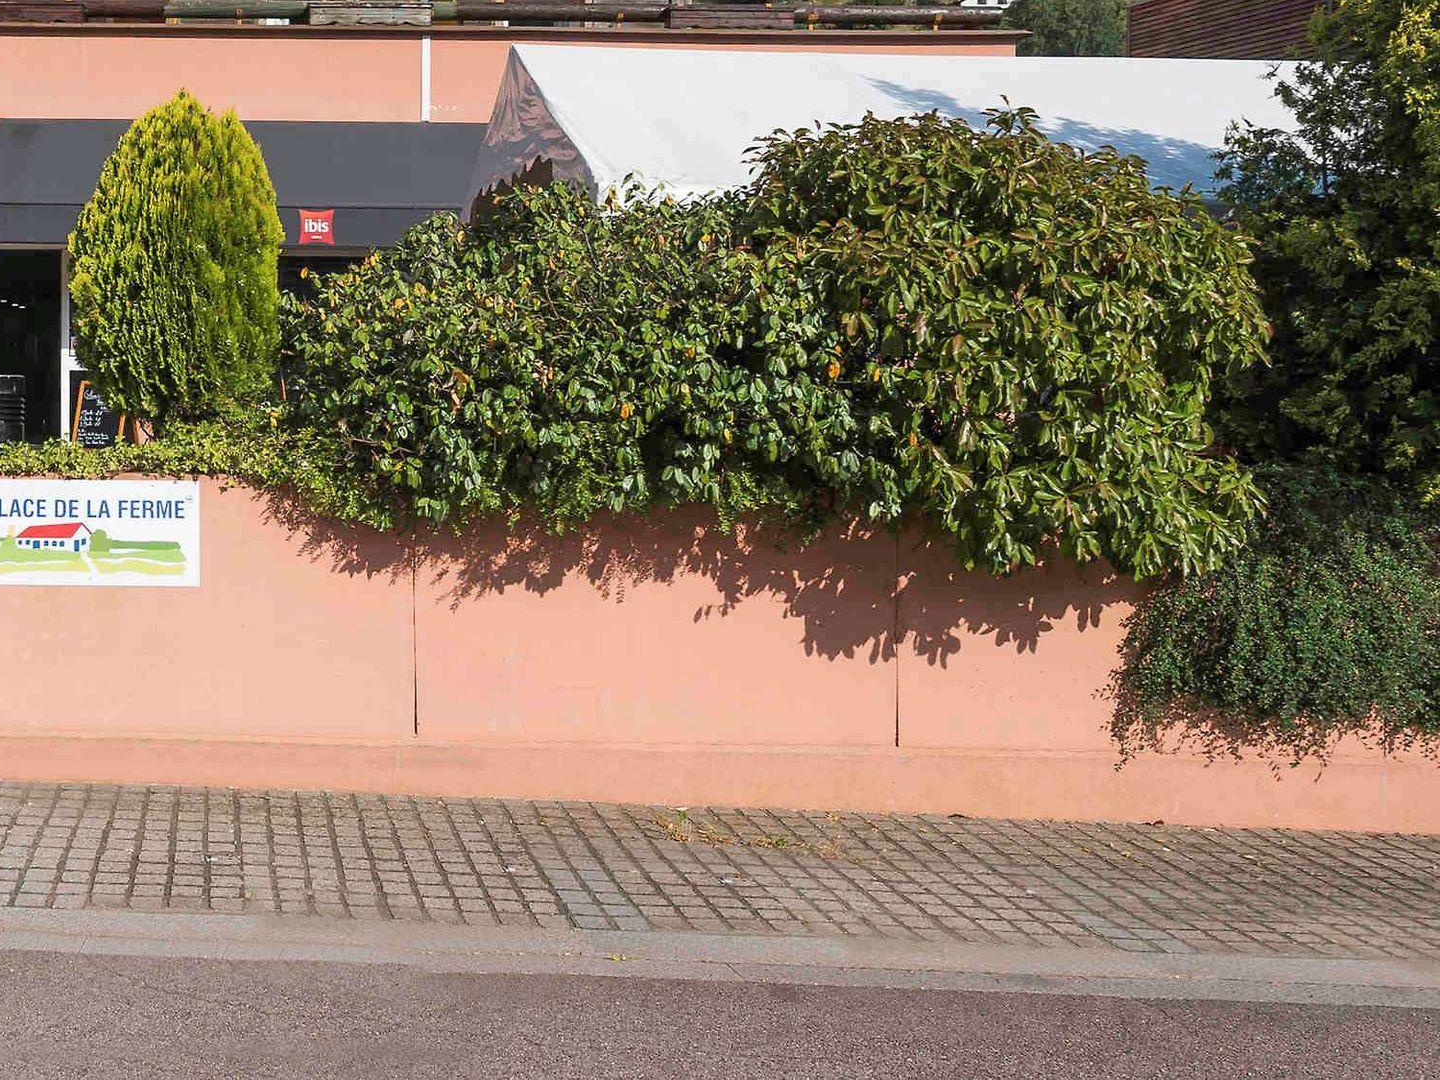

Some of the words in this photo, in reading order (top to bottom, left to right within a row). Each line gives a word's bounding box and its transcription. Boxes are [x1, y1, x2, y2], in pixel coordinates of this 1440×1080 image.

[304, 218, 329, 233] ibis
[54, 499, 79, 518] DE
[87, 499, 111, 519] LA
[118, 500, 185, 519] FERME
